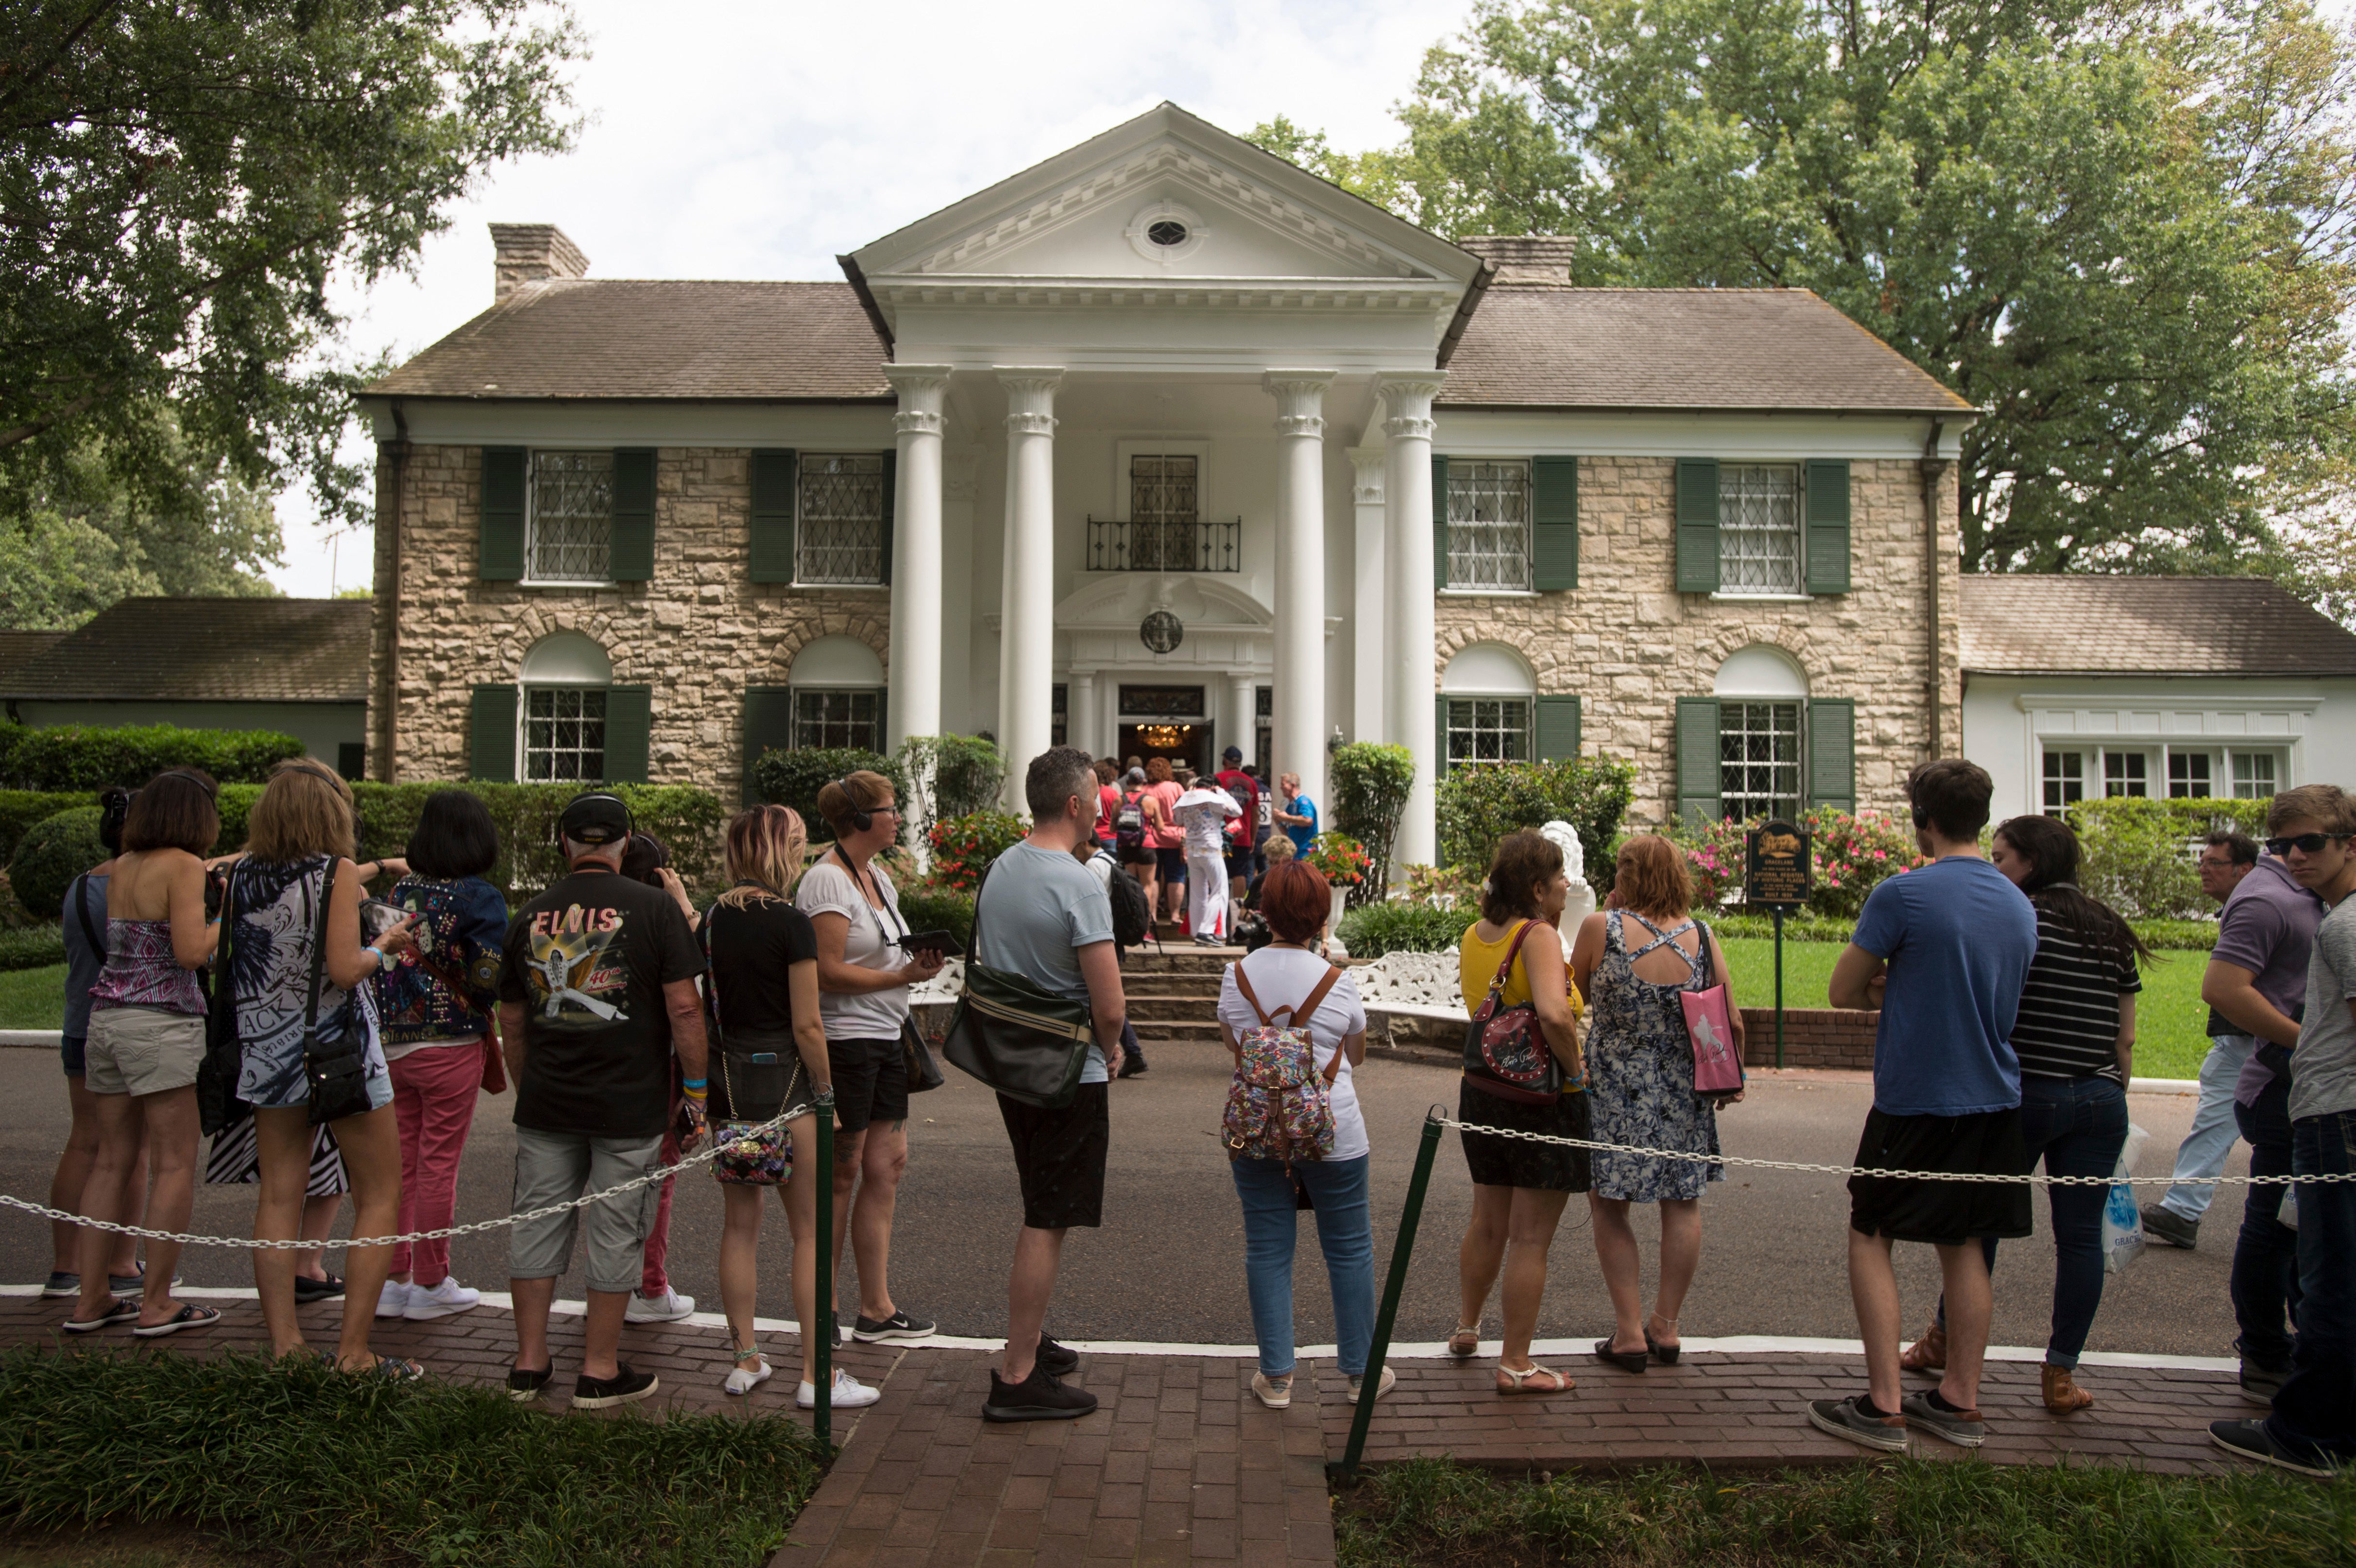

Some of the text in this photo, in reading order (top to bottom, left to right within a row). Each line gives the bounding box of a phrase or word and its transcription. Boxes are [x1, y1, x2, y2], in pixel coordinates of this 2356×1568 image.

[1258, 792, 1272, 801] SA
[533, 908, 617, 936] ELVIS
[589, 967, 621, 985] 40th
